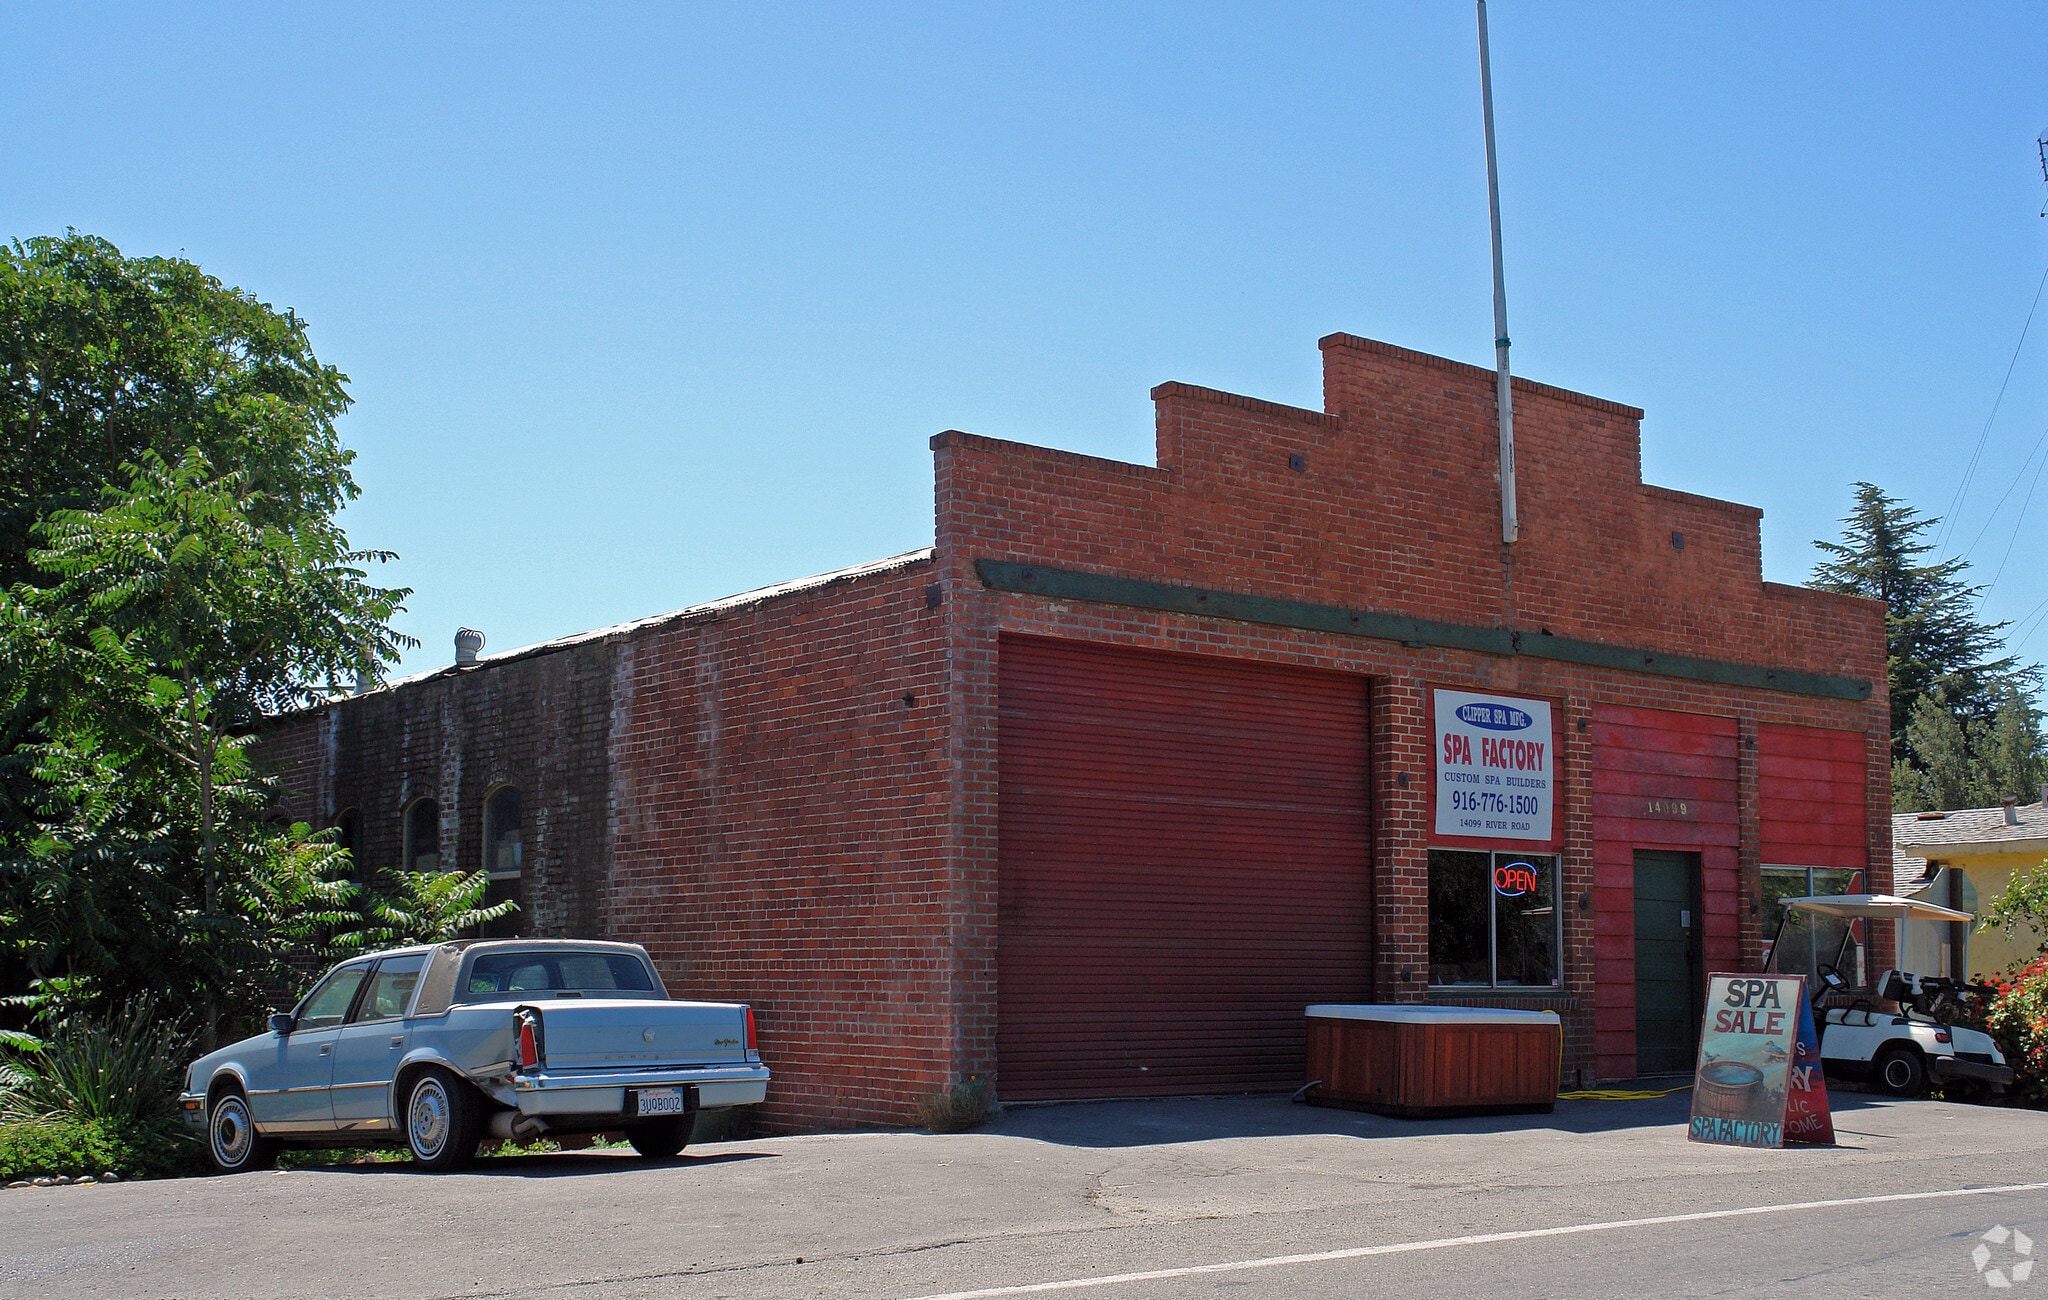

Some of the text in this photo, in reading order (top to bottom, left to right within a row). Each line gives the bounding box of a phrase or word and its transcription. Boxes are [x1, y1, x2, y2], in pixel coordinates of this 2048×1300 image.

[1462, 706, 1527, 727] CLIPPER SPA MFG.
[1443, 733, 1545, 772] SPA FACTORY
[1444, 772, 1546, 789] CUSTOM SPA BUILDERS
[1452, 790, 1538, 815] 916-776-1500
[1648, 801, 1687, 815] 14099
[1460, 818, 1530, 831] 14099 RIVER ROAD
[1494, 867, 1536, 891] OPEN
[1724, 979, 1781, 1009] SPA
[1713, 1009, 1786, 1035] SALE
